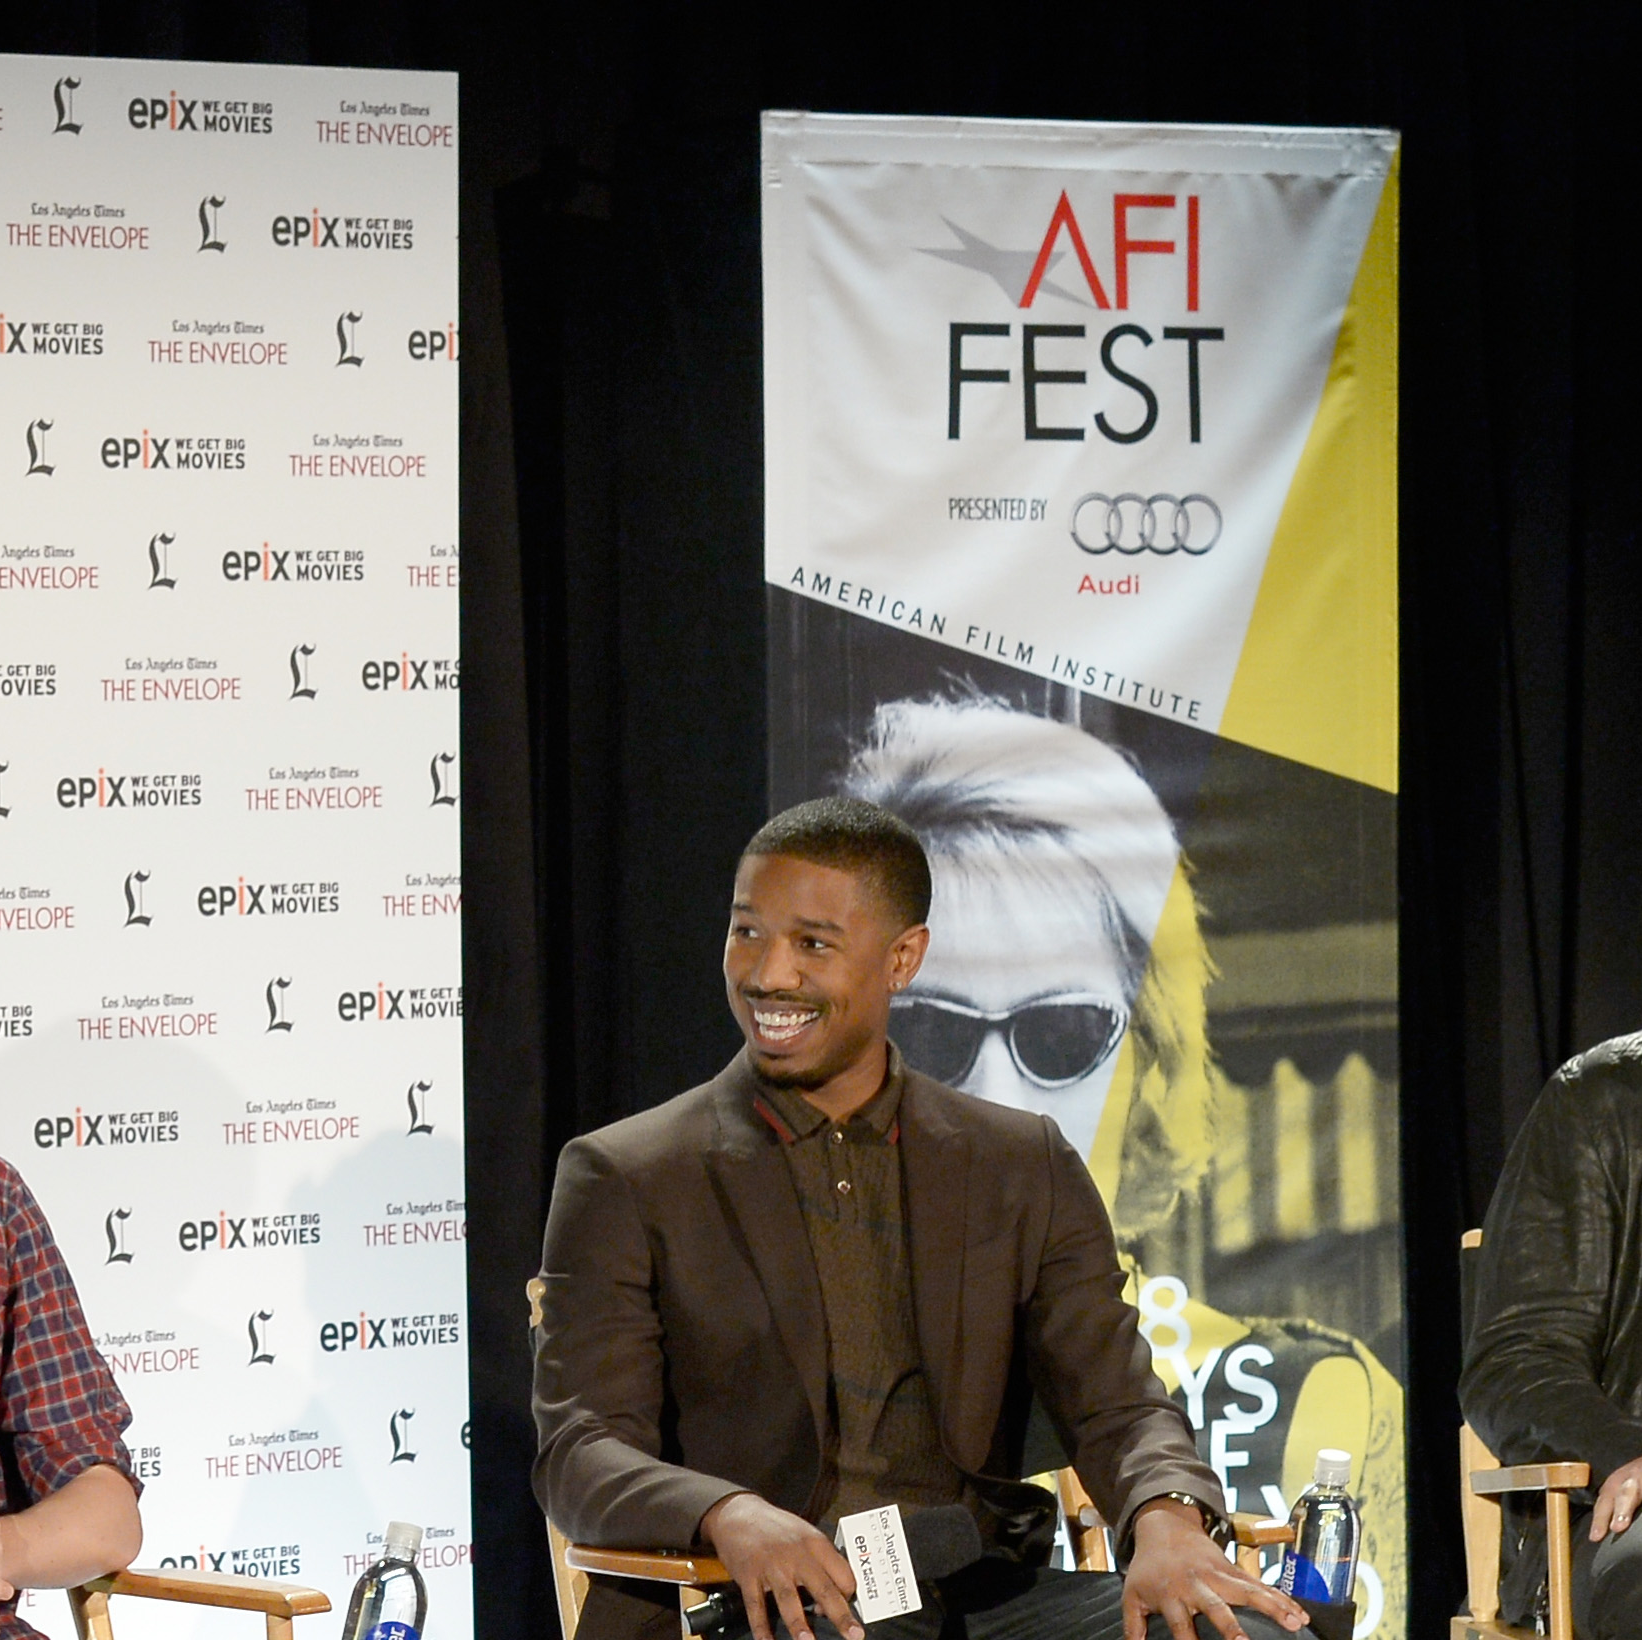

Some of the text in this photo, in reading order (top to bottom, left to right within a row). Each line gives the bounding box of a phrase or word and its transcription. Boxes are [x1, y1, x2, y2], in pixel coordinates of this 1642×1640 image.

[201, 100, 273, 116] WE GET BIG
[203, 114, 273, 135] MOVIES
[315, 119, 453, 148] THE ENVELOPE
[5, 222, 150, 250] THE ENVELOPE
[345, 231, 414, 251] MOVIES
[1018, 188, 1200, 311] AFI
[30, 322, 104, 336] WE GET BIG
[171, 318, 265, 337] Los Angeles Times
[33, 336, 104, 356] MOVIES
[147, 340, 288, 366] THE ENVELOPE
[948, 322, 1224, 444] FEST
[312, 433, 404, 450] Los Angeles Times
[176, 451, 246, 470] MOVIES
[288, 454, 427, 478] THE ENVELOPE
[949, 498, 1048, 520] PRESENTED BY
[296, 563, 365, 582] MOVIES
[1078, 575, 1140, 595] Audi
[790, 566, 1201, 721] AMERICAN FILM INSTITUTE
[100, 677, 242, 702] THE ENVELOPE
[132, 788, 202, 808] MOVIES
[244, 786, 383, 811] THE ENVELOPE
[271, 895, 340, 915] MOVIES
[11, 1005, 33, 1018] BIG
[101, 993, 195, 1010] Los Angeles Times
[76, 1012, 218, 1041] THE ENVELOPE
[109, 1124, 179, 1145] MOVIES
[252, 1226, 321, 1248] MOVIES
[1138, 1275, 1191, 1358] 8
[392, 1326, 459, 1348] MOVIES
[204, 1447, 343, 1479] THE ENVELOPE
[879, 1510, 909, 1611] Los Angeles Times
